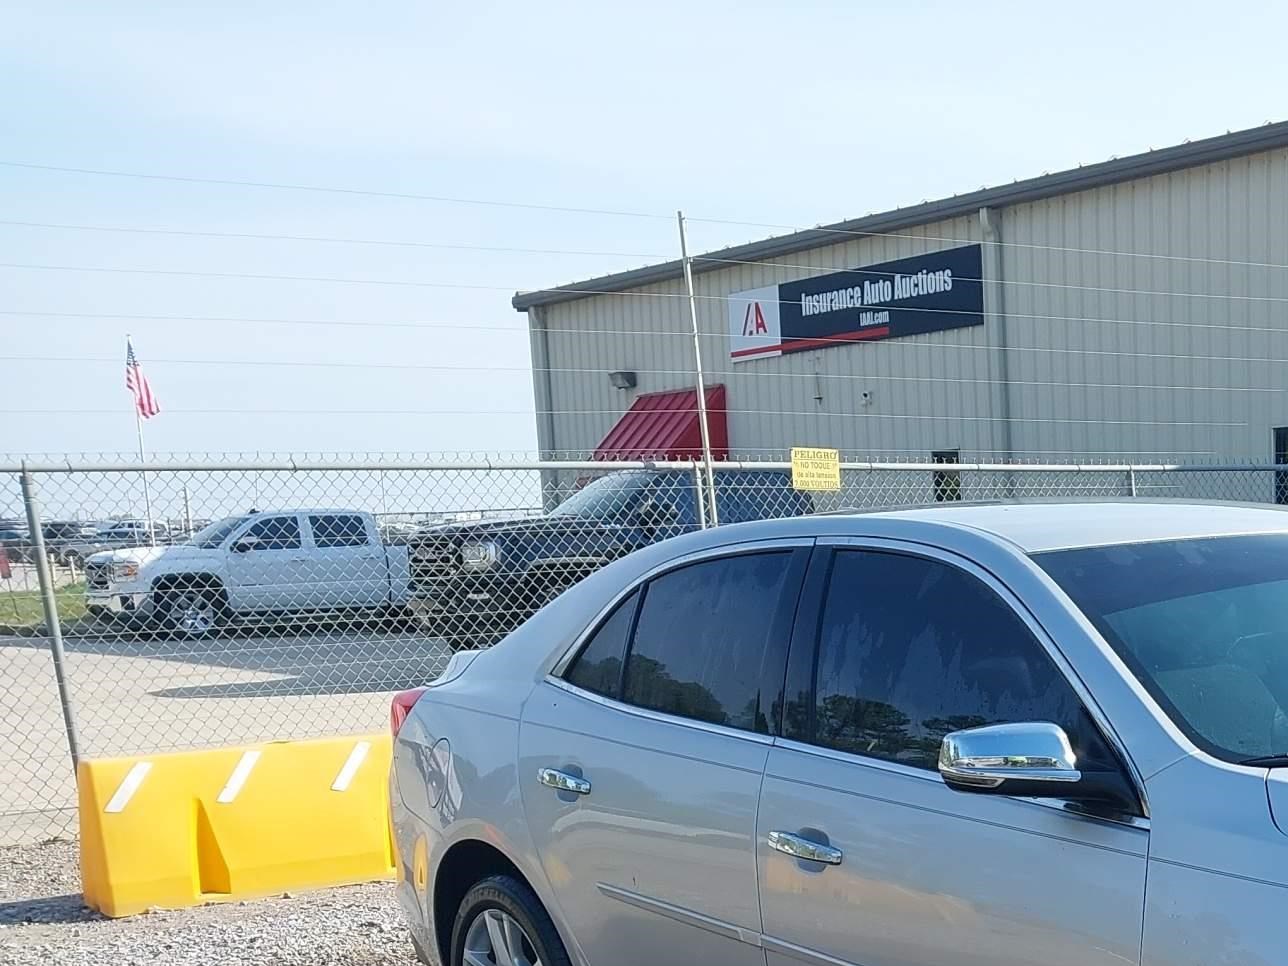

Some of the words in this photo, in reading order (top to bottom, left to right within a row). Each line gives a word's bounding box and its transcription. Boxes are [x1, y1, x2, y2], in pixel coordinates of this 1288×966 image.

[801, 286, 861, 316] Insurance
[863, 279, 891, 305] Auto
[894, 269, 952, 300] Auctions
[860, 311, 889, 326] IAAI.com
[794, 450, 838, 459] PELIGRO
